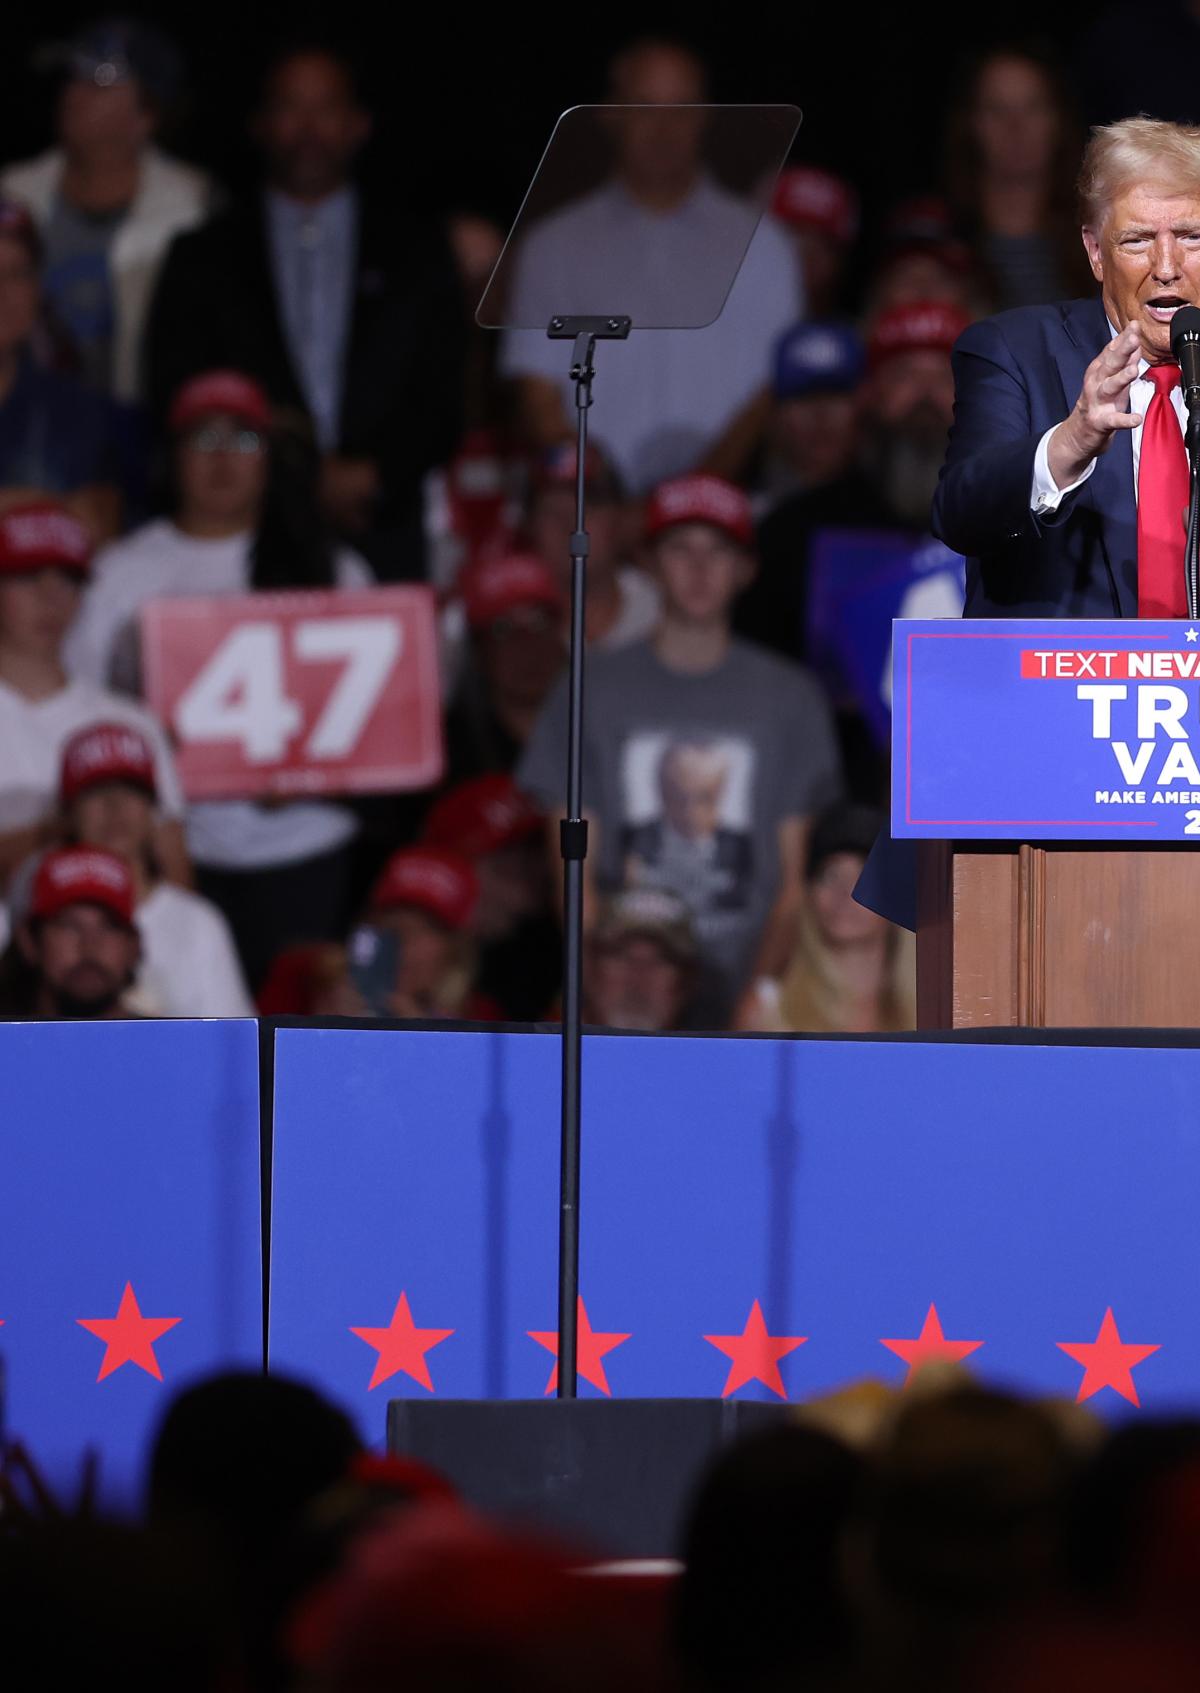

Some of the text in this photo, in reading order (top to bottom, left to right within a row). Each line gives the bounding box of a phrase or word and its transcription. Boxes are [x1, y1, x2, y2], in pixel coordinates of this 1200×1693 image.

[1034, 652, 1118, 677] TEXT
[174, 616, 402, 762] 47
[1095, 790, 1147, 805] MAKE
